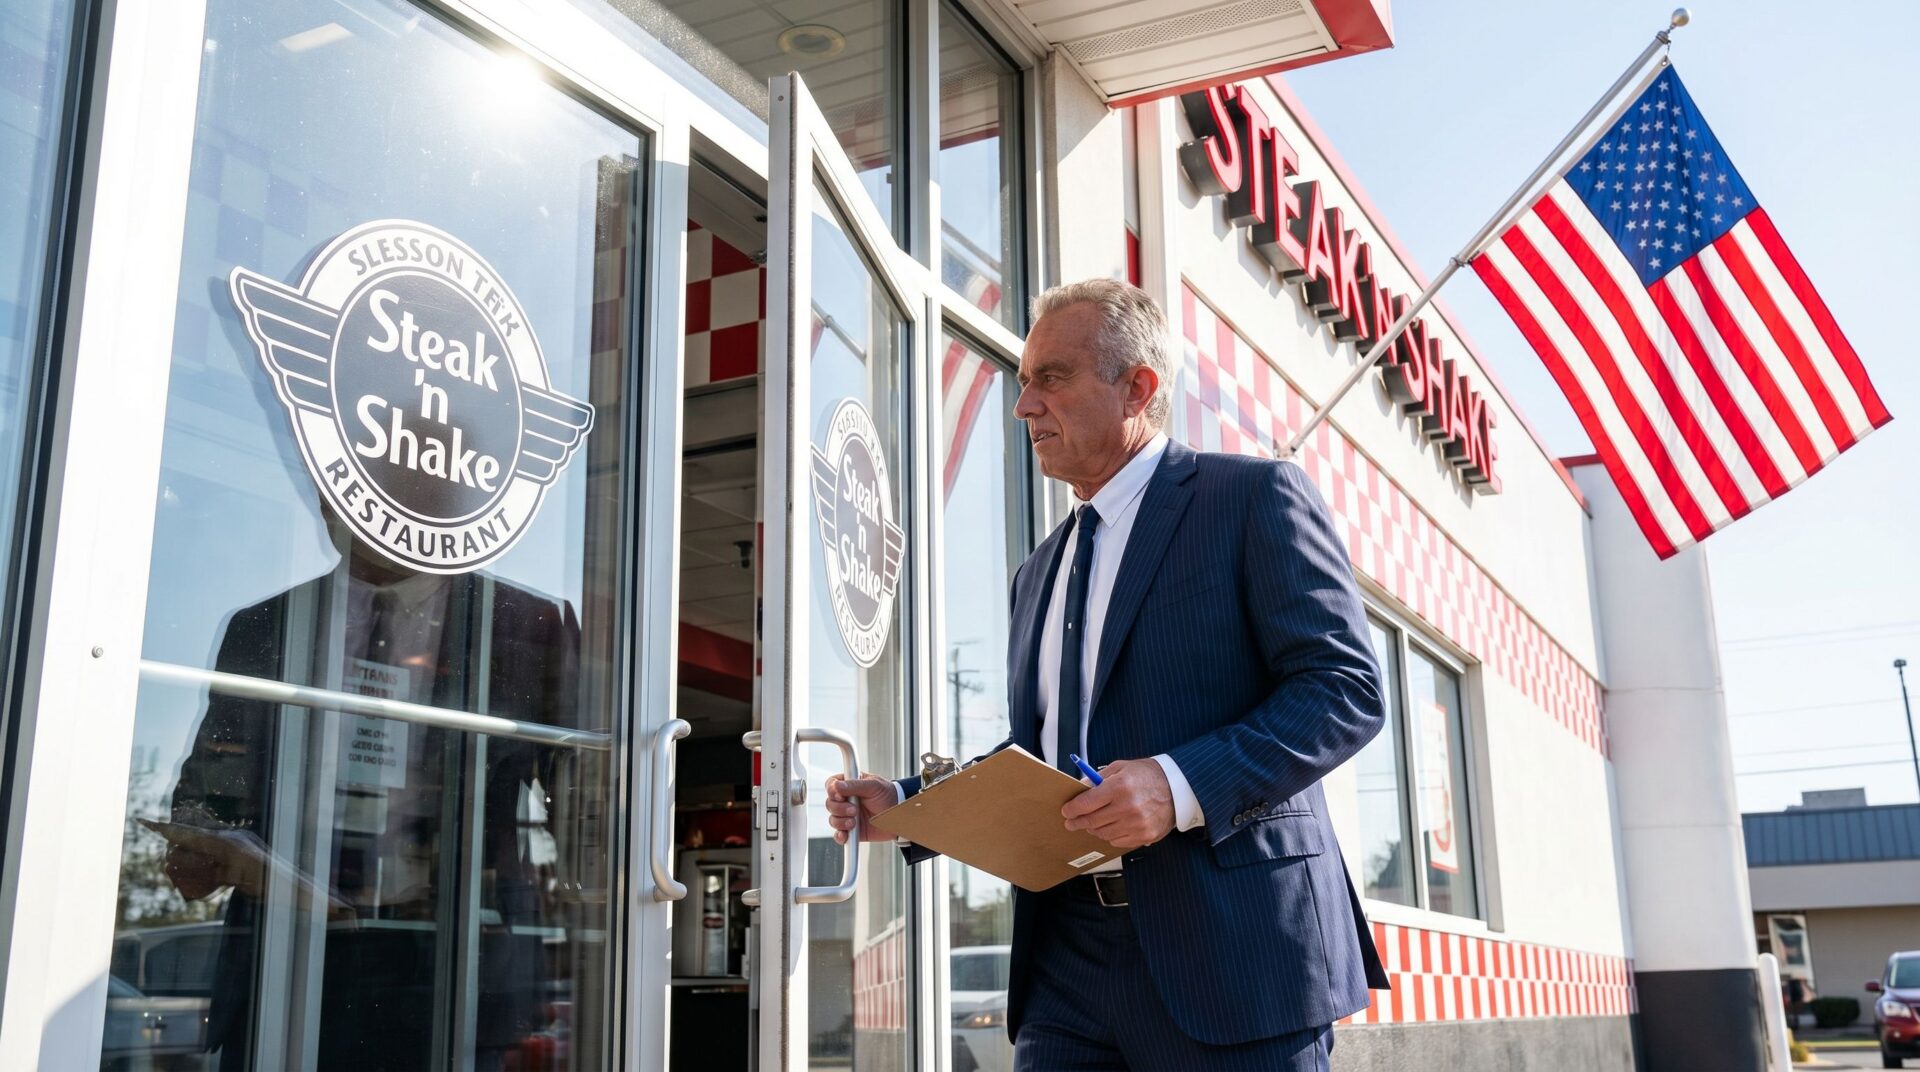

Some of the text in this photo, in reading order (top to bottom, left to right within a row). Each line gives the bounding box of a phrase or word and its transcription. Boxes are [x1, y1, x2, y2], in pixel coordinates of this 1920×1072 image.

[348, 236, 464, 280] SLESSON
[1204, 84, 1369, 340] STEAK
[1402, 293, 1502, 494] SHAKE
[367, 289, 499, 392] Steak
[415, 369, 448, 425] 'n
[355, 394, 500, 492] Shake
[325, 457, 511, 559] RESTAURANT
[843, 454, 880, 526] Steak
[841, 533, 881, 602] Shake
